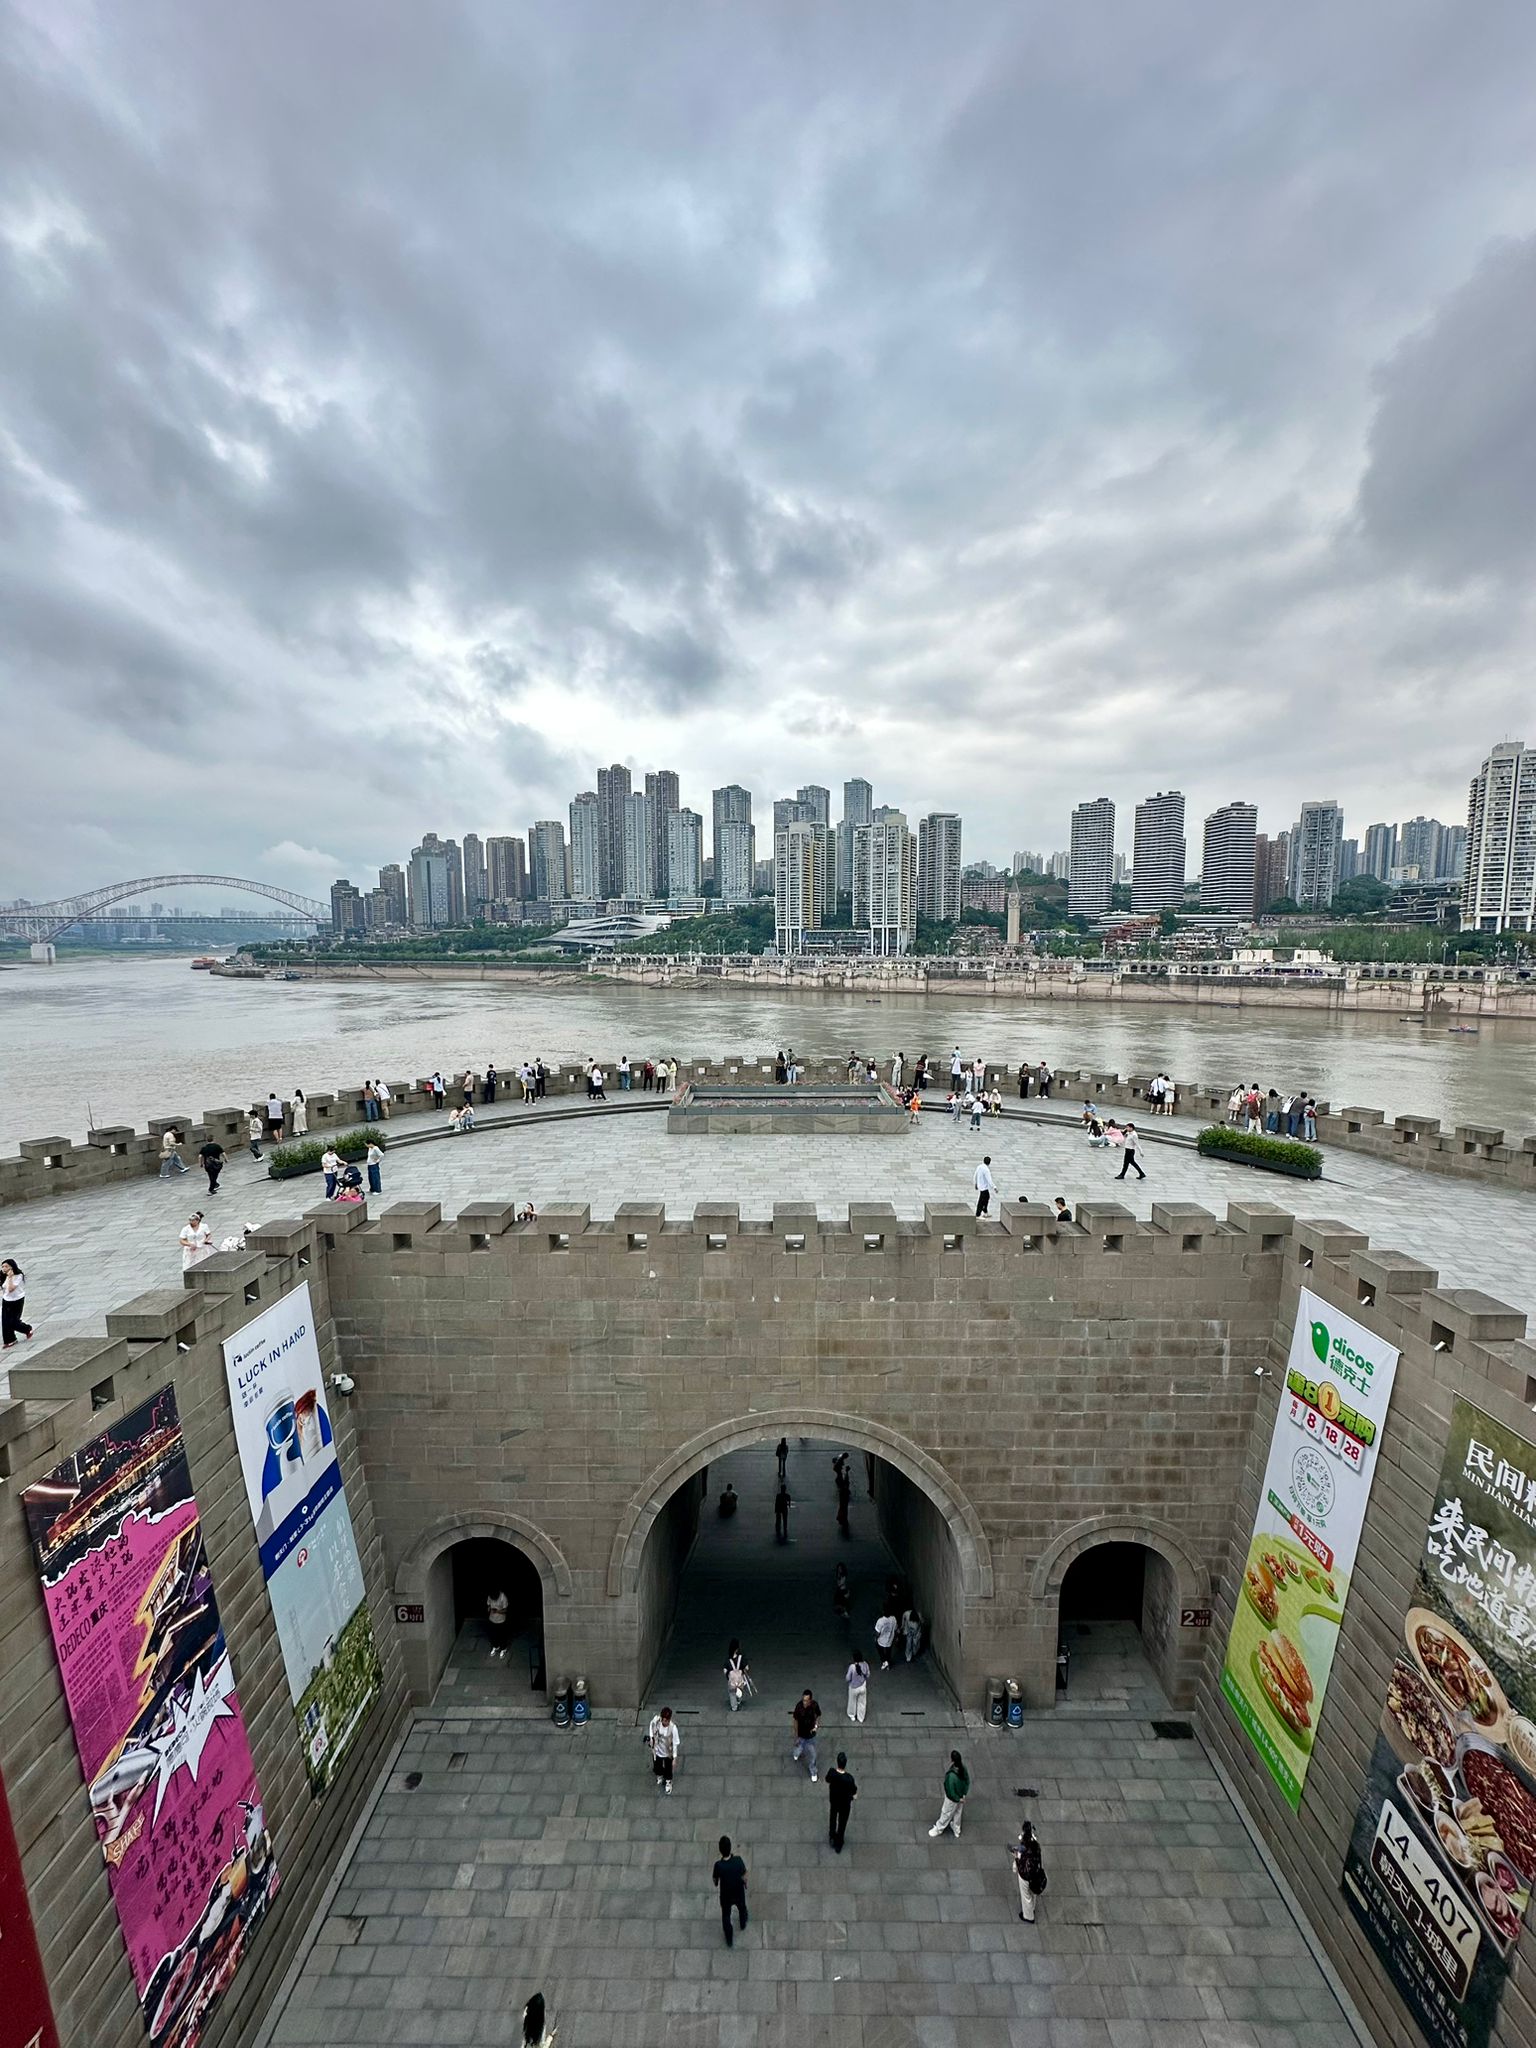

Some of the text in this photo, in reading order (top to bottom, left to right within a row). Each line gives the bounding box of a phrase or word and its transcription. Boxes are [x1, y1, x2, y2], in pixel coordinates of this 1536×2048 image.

[237, 1325, 306, 1389] LUCK IN HAND
[1329, 1355, 1371, 1398] 德克士
[1332, 1337, 1375, 1377] dicos
[1462, 1466, 1485, 1488] MIN
[1484, 1484, 1511, 1508] JIAN
[1298, 1523, 1329, 1566] 1元购
[58, 1617, 91, 1663] DEDECO
[90, 1601, 109, 1628] 重庆
[397, 1606, 409, 1622] 6
[1182, 1611, 1195, 1626] 2
[1377, 1853, 1459, 1984] 朝天门-城里
